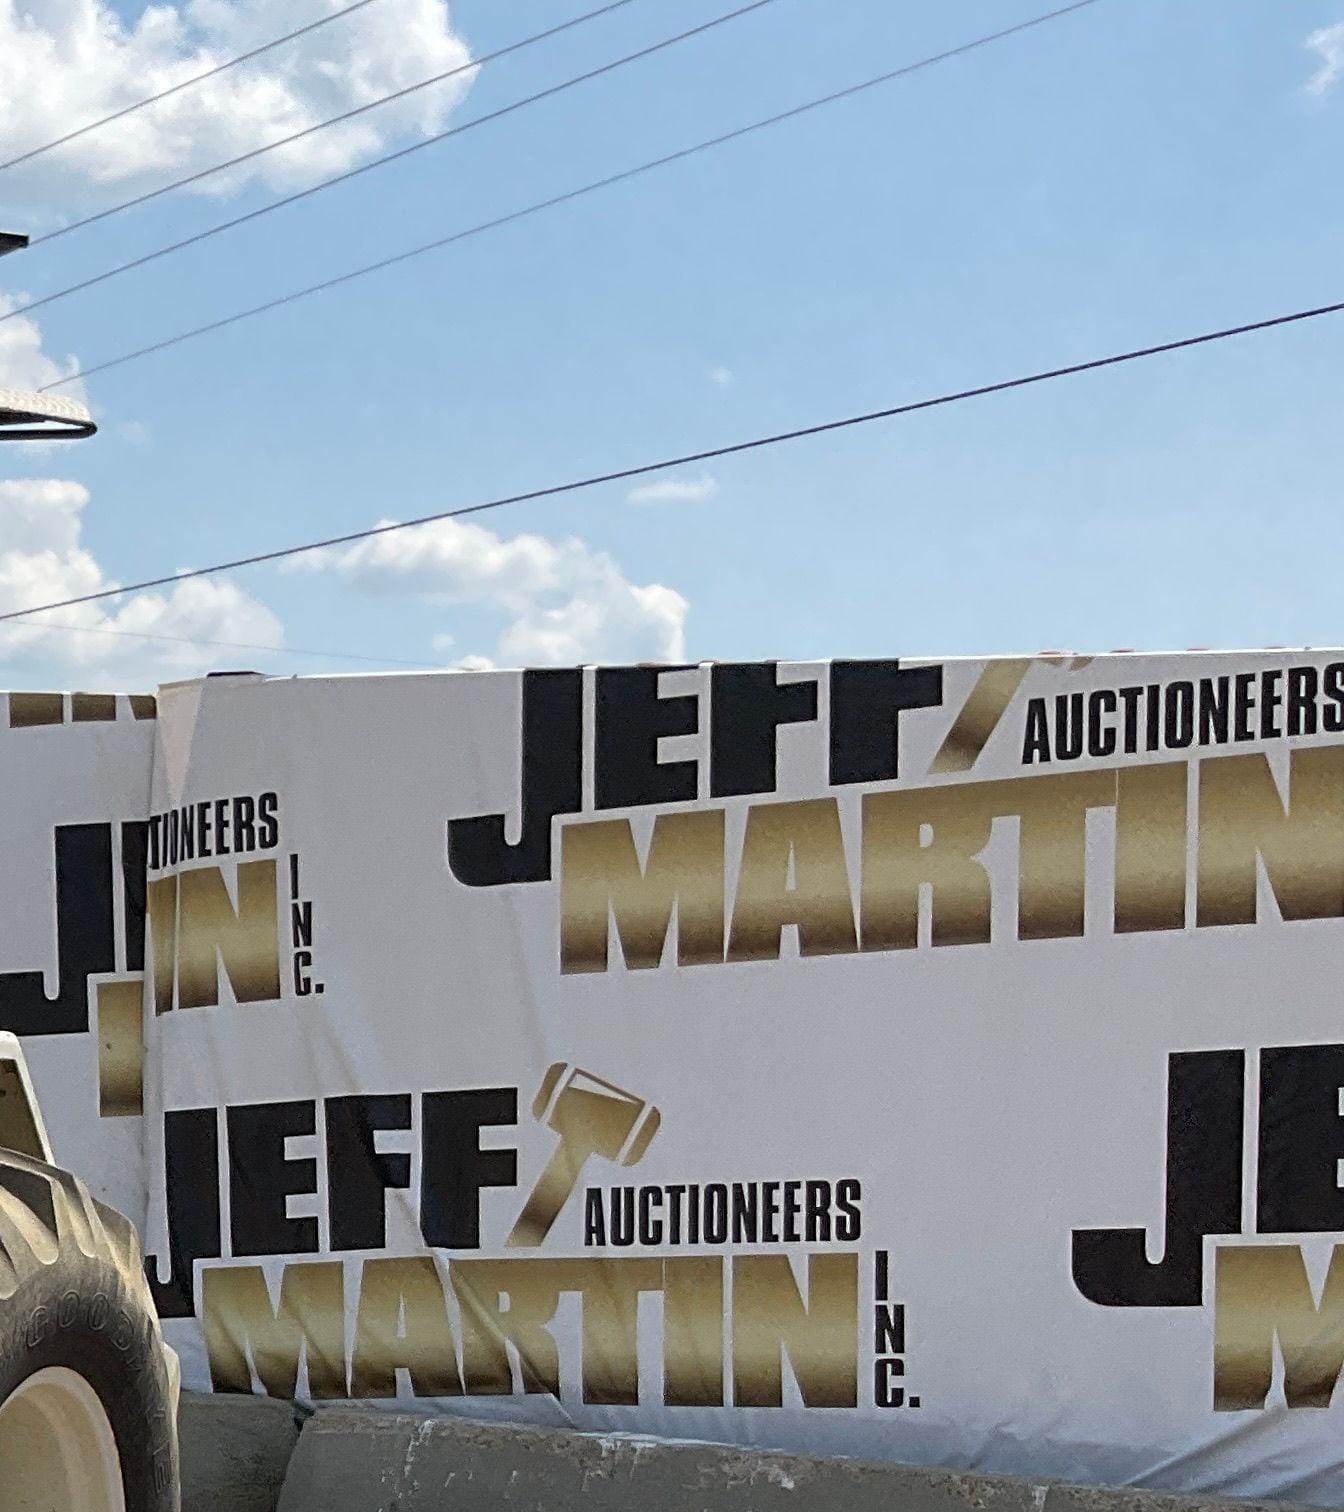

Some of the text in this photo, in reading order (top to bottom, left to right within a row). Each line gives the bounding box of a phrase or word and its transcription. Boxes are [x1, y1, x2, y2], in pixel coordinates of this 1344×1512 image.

[448, 658, 944, 888] JEFF
[289, 853, 325, 997] INC.
[559, 744, 1344, 976] MARTIN
[143, 1087, 519, 1318] JEFF
[583, 1178, 862, 1247] AUCTIONEERS
[201, 1251, 860, 1410] MARTIN
[874, 1249, 921, 1409] INC.
